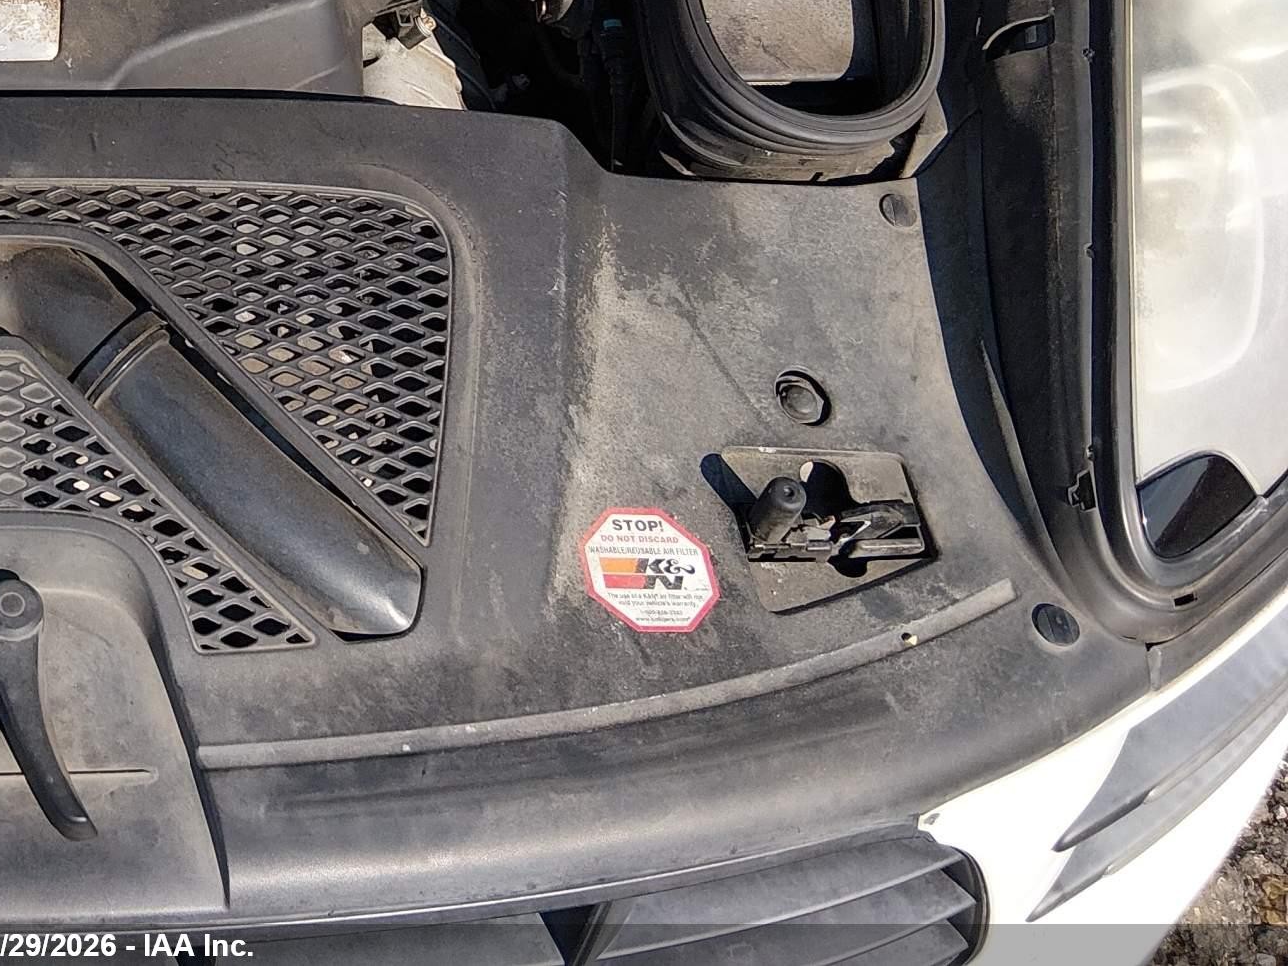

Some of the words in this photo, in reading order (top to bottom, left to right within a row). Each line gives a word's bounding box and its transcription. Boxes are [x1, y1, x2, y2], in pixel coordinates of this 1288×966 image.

[612, 519, 664, 532] STOP!
[616, 535, 636, 543] NOT
[639, 536, 679, 544] DISCARD
[663, 547, 675, 555] AIR
[676, 547, 698, 556] FILTER
